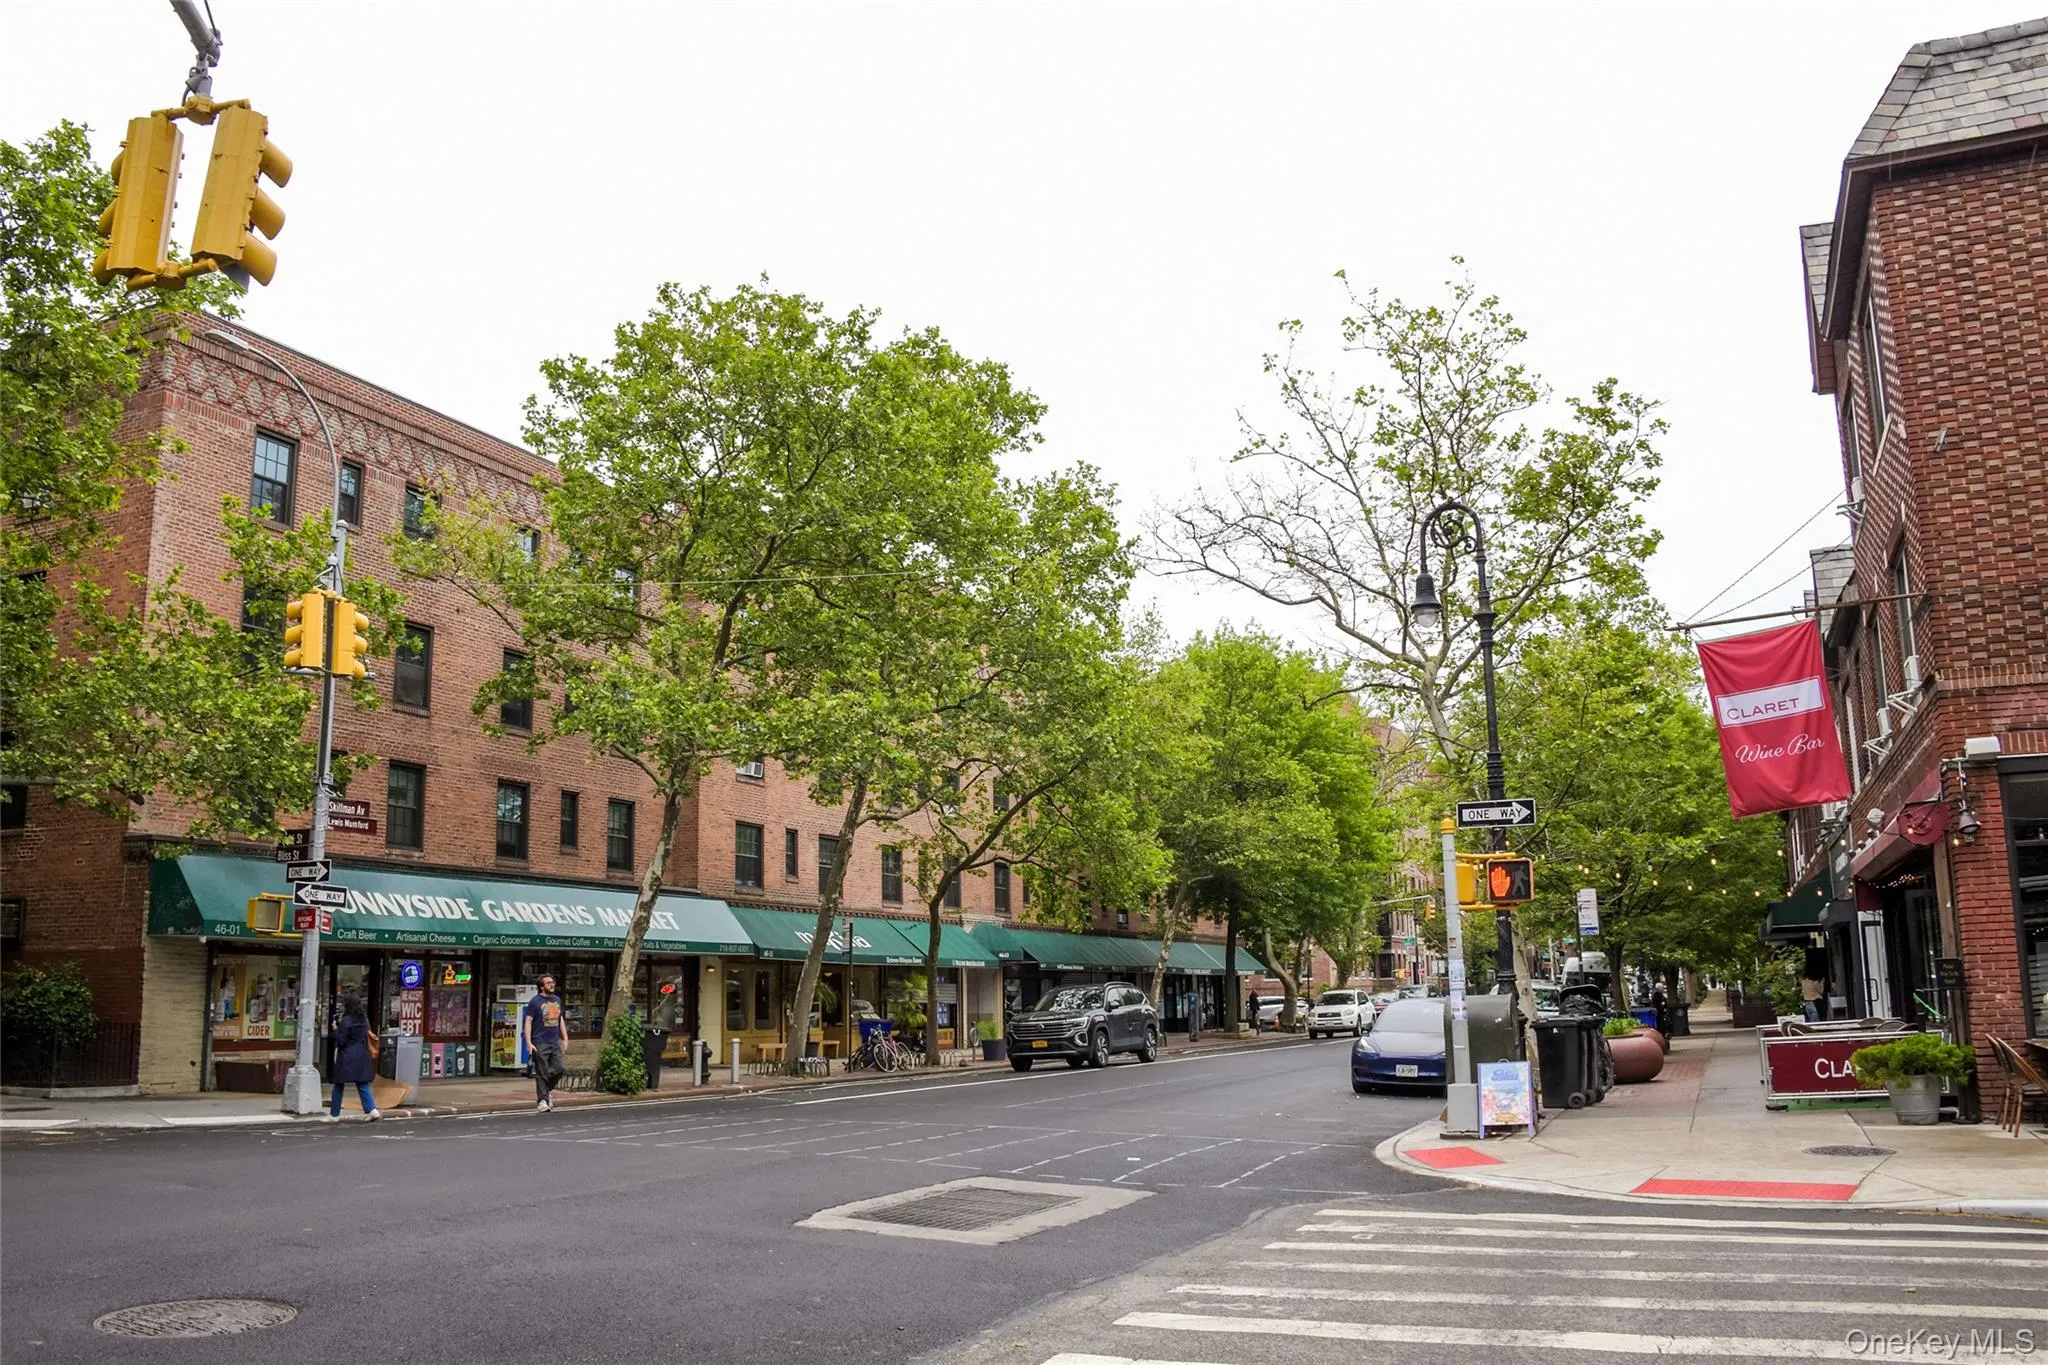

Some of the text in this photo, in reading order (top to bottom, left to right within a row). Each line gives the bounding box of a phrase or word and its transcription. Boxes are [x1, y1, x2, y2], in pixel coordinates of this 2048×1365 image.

[1727, 698, 1799, 720] CLARET
[1735, 734, 1825, 764] Wine Bar
[329, 801, 366, 816] Skillman Av
[1468, 808, 1522, 820] ONE WAY
[328, 817, 369, 830] Lewis Mumford
[290, 867, 322, 877] ONE WAY
[304, 890, 342, 901] ONE WAY
[321, 890, 680, 931] UNNYSIDE GARDENS MAKET
[214, 923, 240, 935] 46-01
[337, 928, 357, 940] Craft
[358, 929, 377, 940] Beer
[396, 932, 428, 942] Artisanal
[429, 931, 456, 943] Cheese
[473, 934, 500, 946] Organic
[500, 935, 531, 945] Groceries
[545, 937, 571, 946] Gourmet
[571, 938, 591, 946] Coffee
[401, 1002, 422, 1018] WIC
[247, 1025, 270, 1036] CIDER
[401, 1019, 421, 1035] EBT
[1814, 1057, 1856, 1079] CLA
